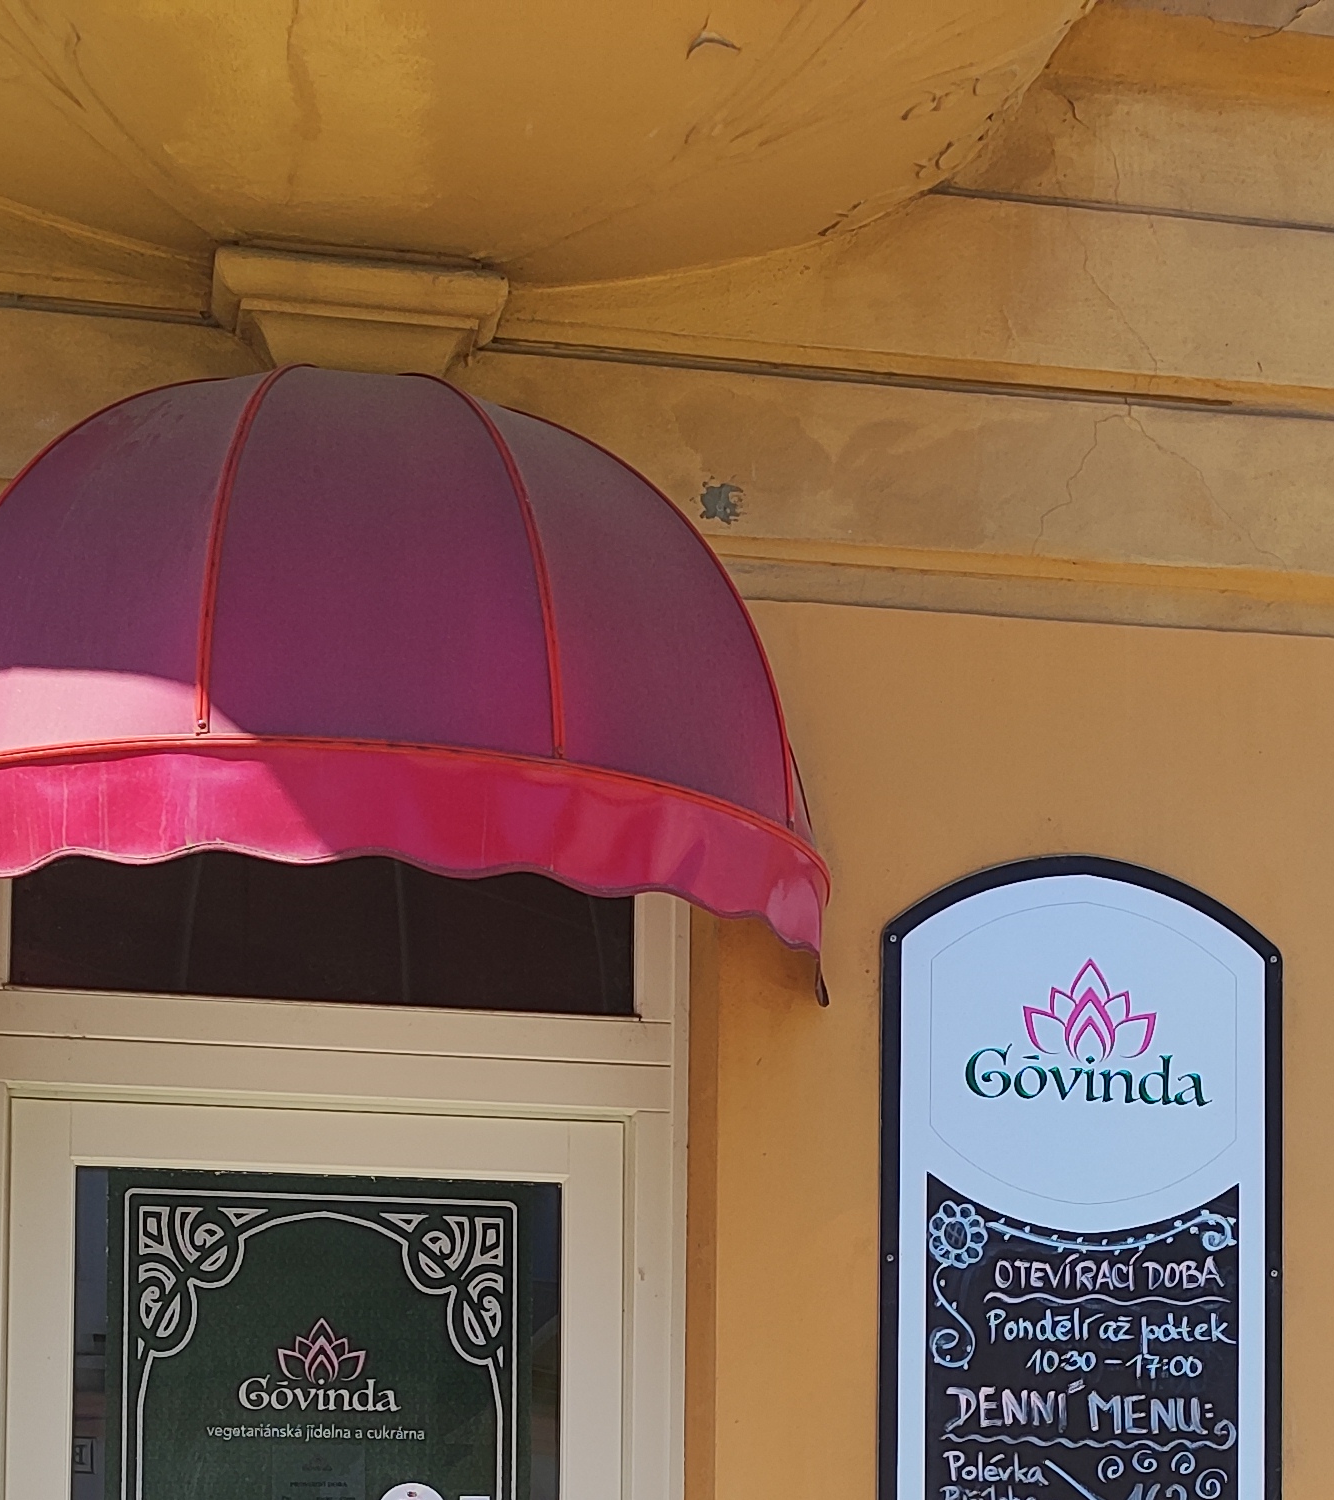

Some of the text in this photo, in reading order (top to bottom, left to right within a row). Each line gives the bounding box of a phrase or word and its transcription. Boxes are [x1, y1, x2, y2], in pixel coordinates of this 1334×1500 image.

[964, 1043, 1212, 1107] Gōvinda
[994, 1252, 1225, 1291] OTEVÍRACÍ DOBA
[986, 1307, 1237, 1355] Pondělí až pátek
[945, 1379, 1214, 1436] DENNÍ MENU:
[206, 1423, 425, 1442] vegetariánská jídelna a cukrárna
[942, 1450, 1050, 1486] Polévka
